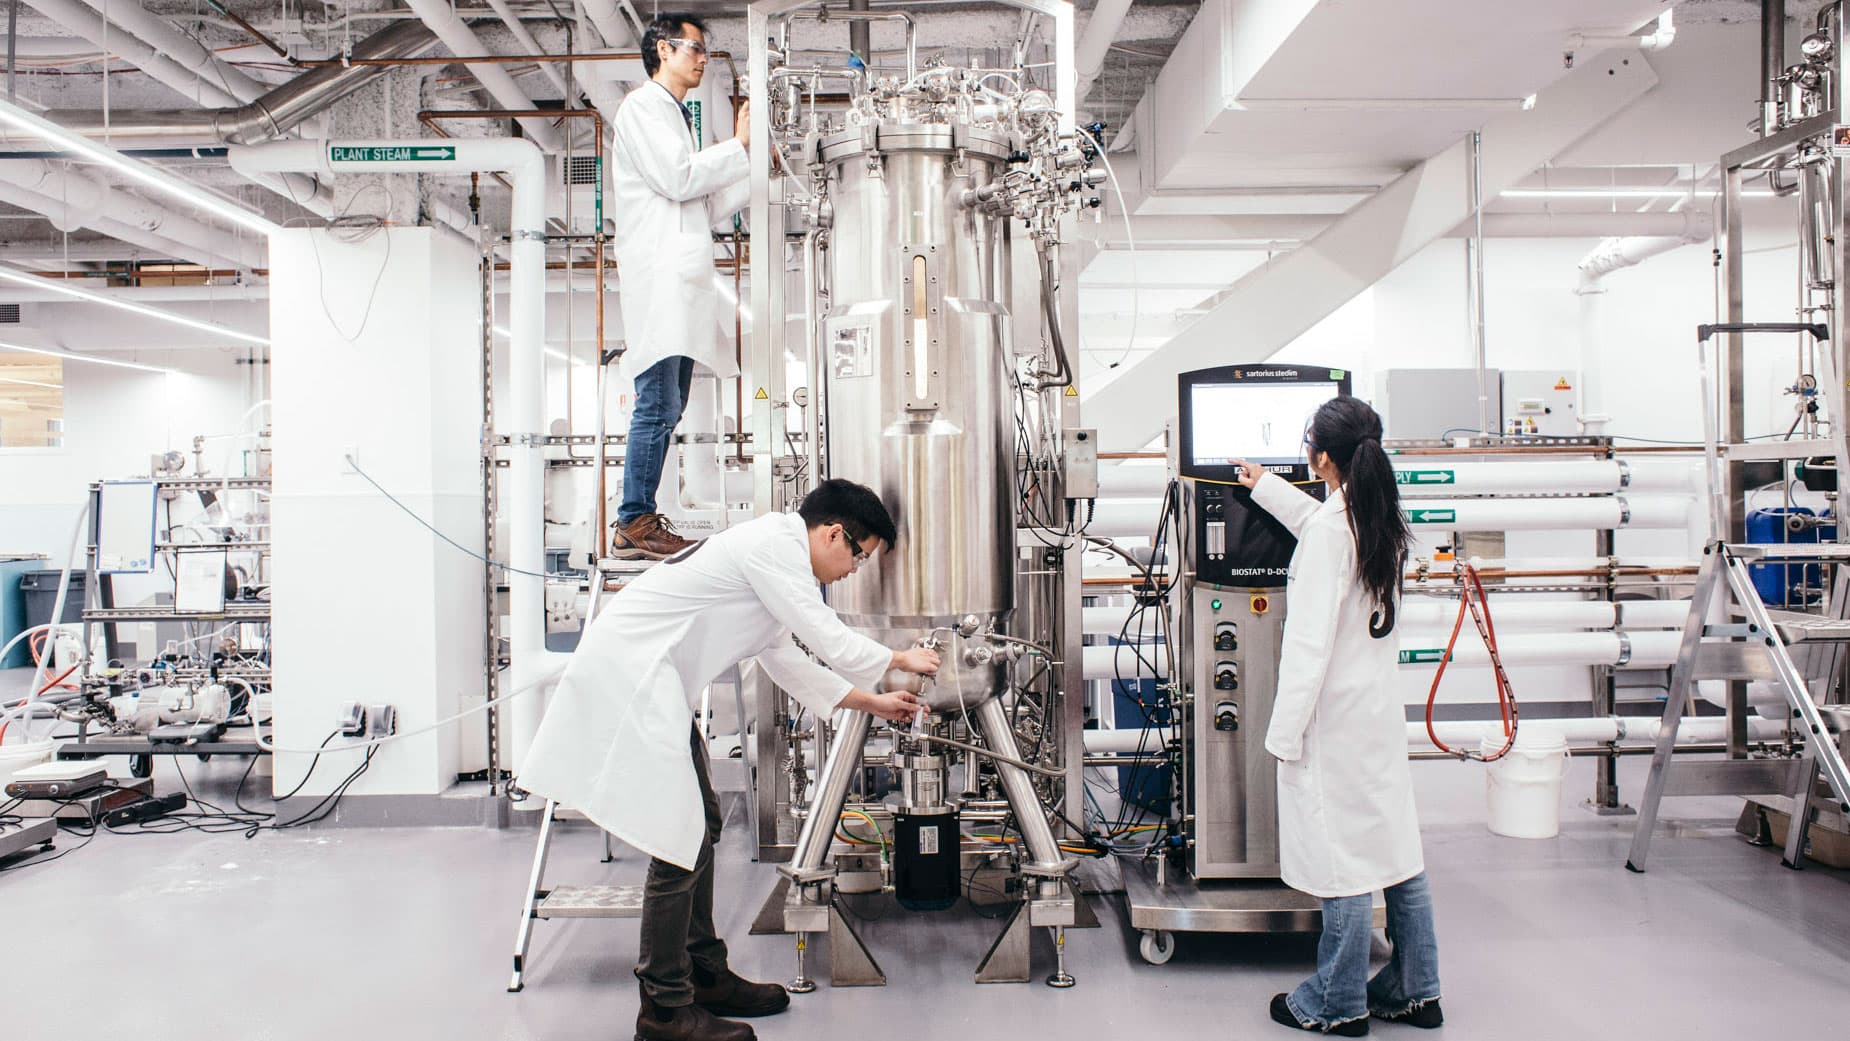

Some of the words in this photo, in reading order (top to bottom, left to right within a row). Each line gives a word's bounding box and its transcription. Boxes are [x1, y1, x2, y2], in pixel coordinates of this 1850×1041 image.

[334, 148, 369, 161] PLANT
[373, 148, 411, 161] STEAM
[1246, 369, 1275, 377] sartorius
[1275, 369, 1298, 377] stedim
